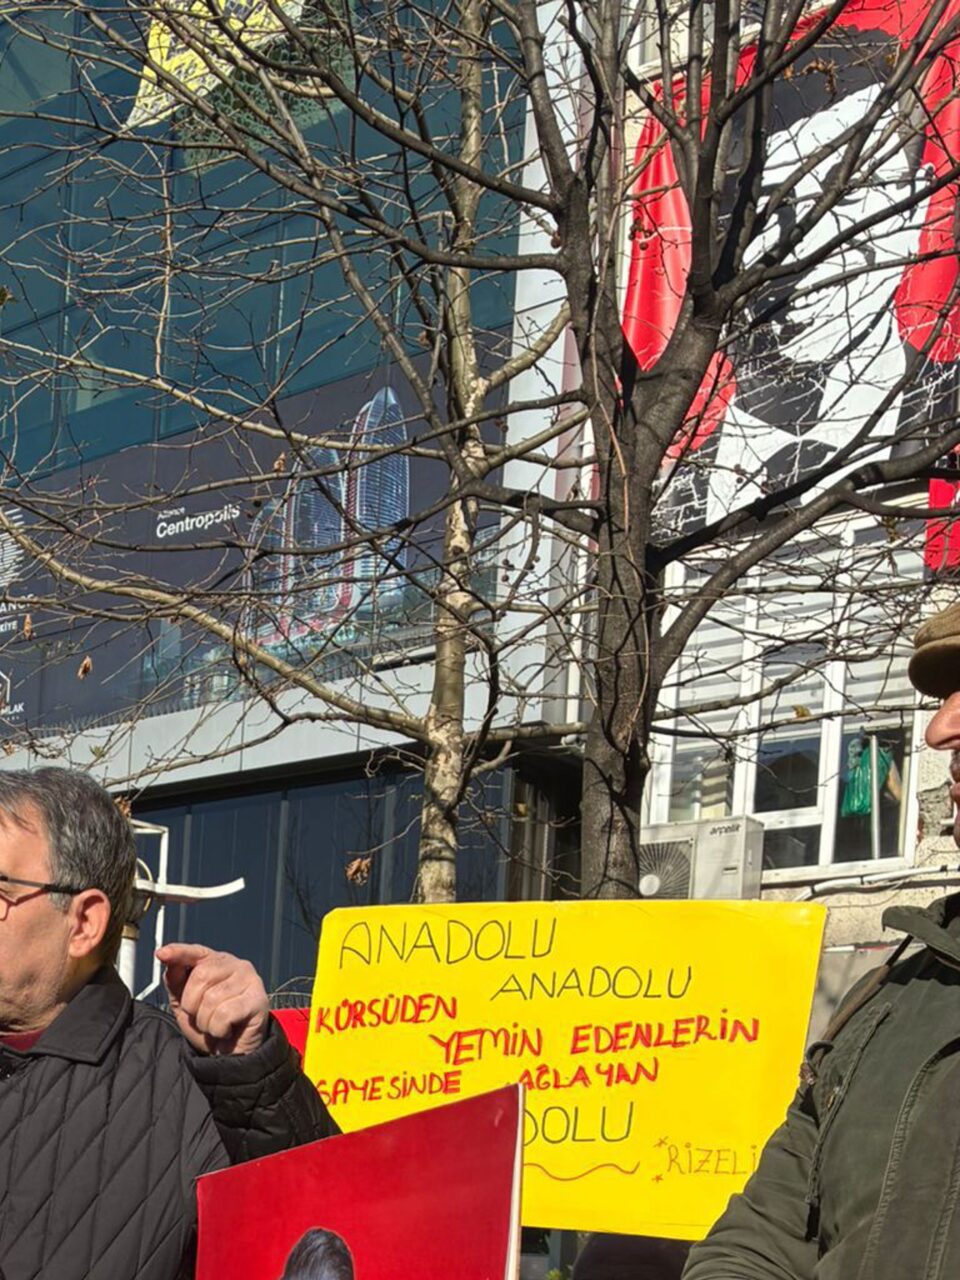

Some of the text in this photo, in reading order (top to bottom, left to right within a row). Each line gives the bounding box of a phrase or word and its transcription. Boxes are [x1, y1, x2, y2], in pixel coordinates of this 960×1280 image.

[156, 504, 240, 538] Centropolis
[339, 917, 557, 969] ANADOLU
[490, 965, 692, 1001] ANADOLU
[428, 1008, 760, 1066] YEMİN EDENLERİN
[316, 1056, 659, 1108] SAYESİNDE AĞLAYAN
